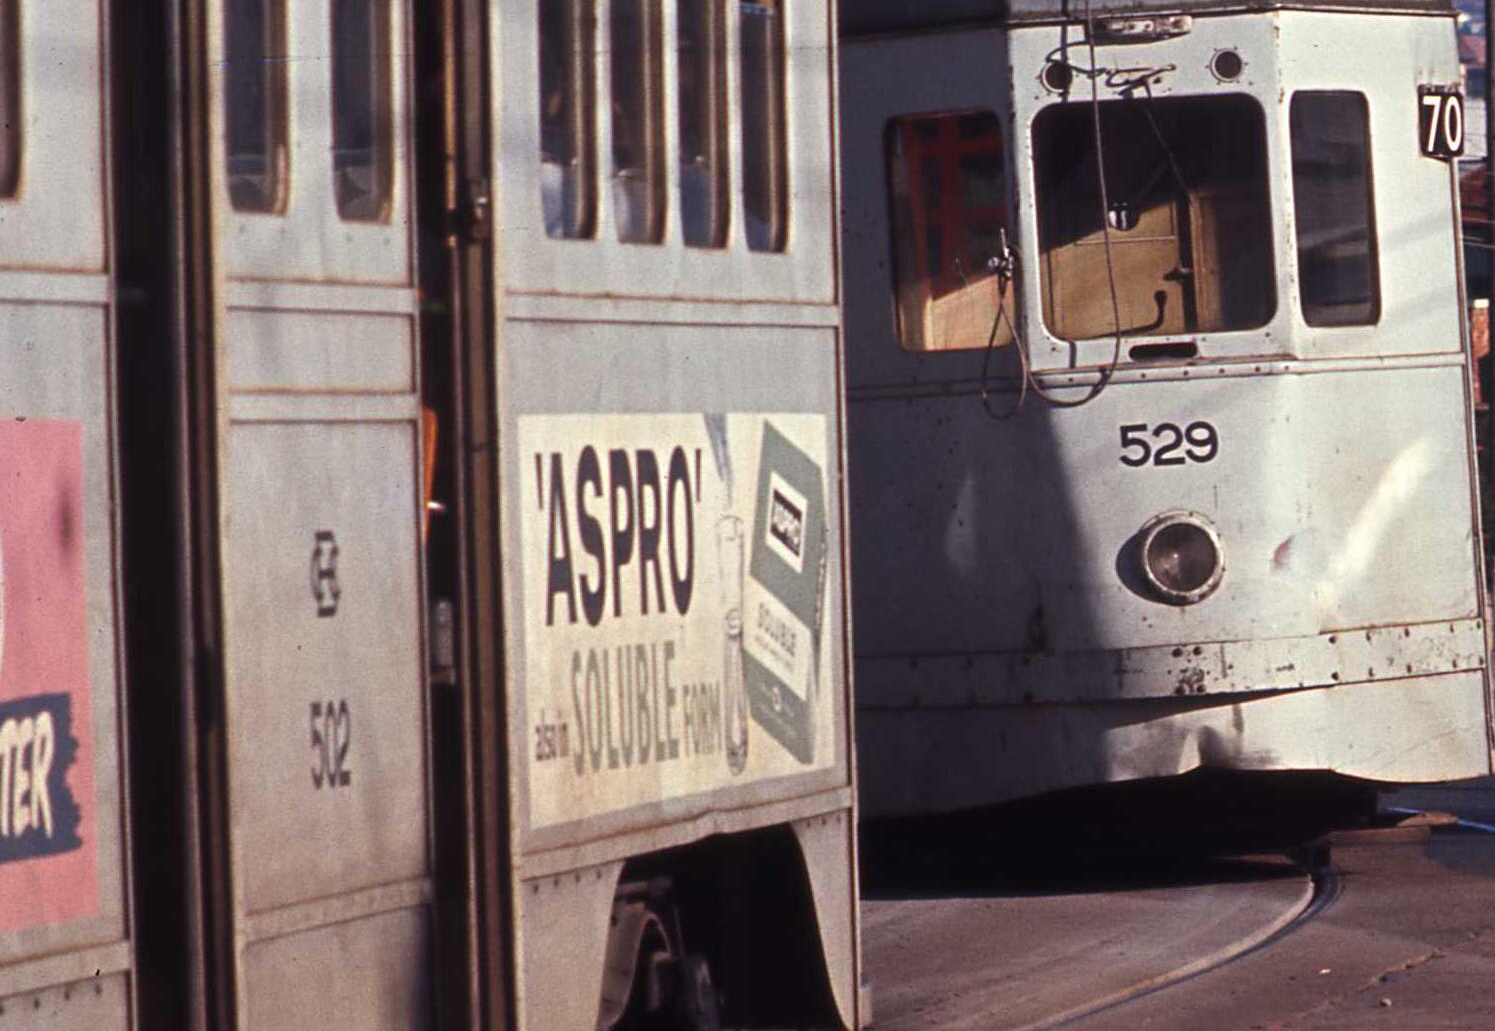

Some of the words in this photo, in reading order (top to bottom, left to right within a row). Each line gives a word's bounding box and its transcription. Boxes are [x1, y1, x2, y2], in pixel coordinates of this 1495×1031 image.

[1422, 95, 1464, 153] 70
[1118, 420, 1219, 467] 529
[310, 699, 352, 790] 502
[570, 640, 680, 777] SOLUBLE
[681, 680, 722, 759] FORM
